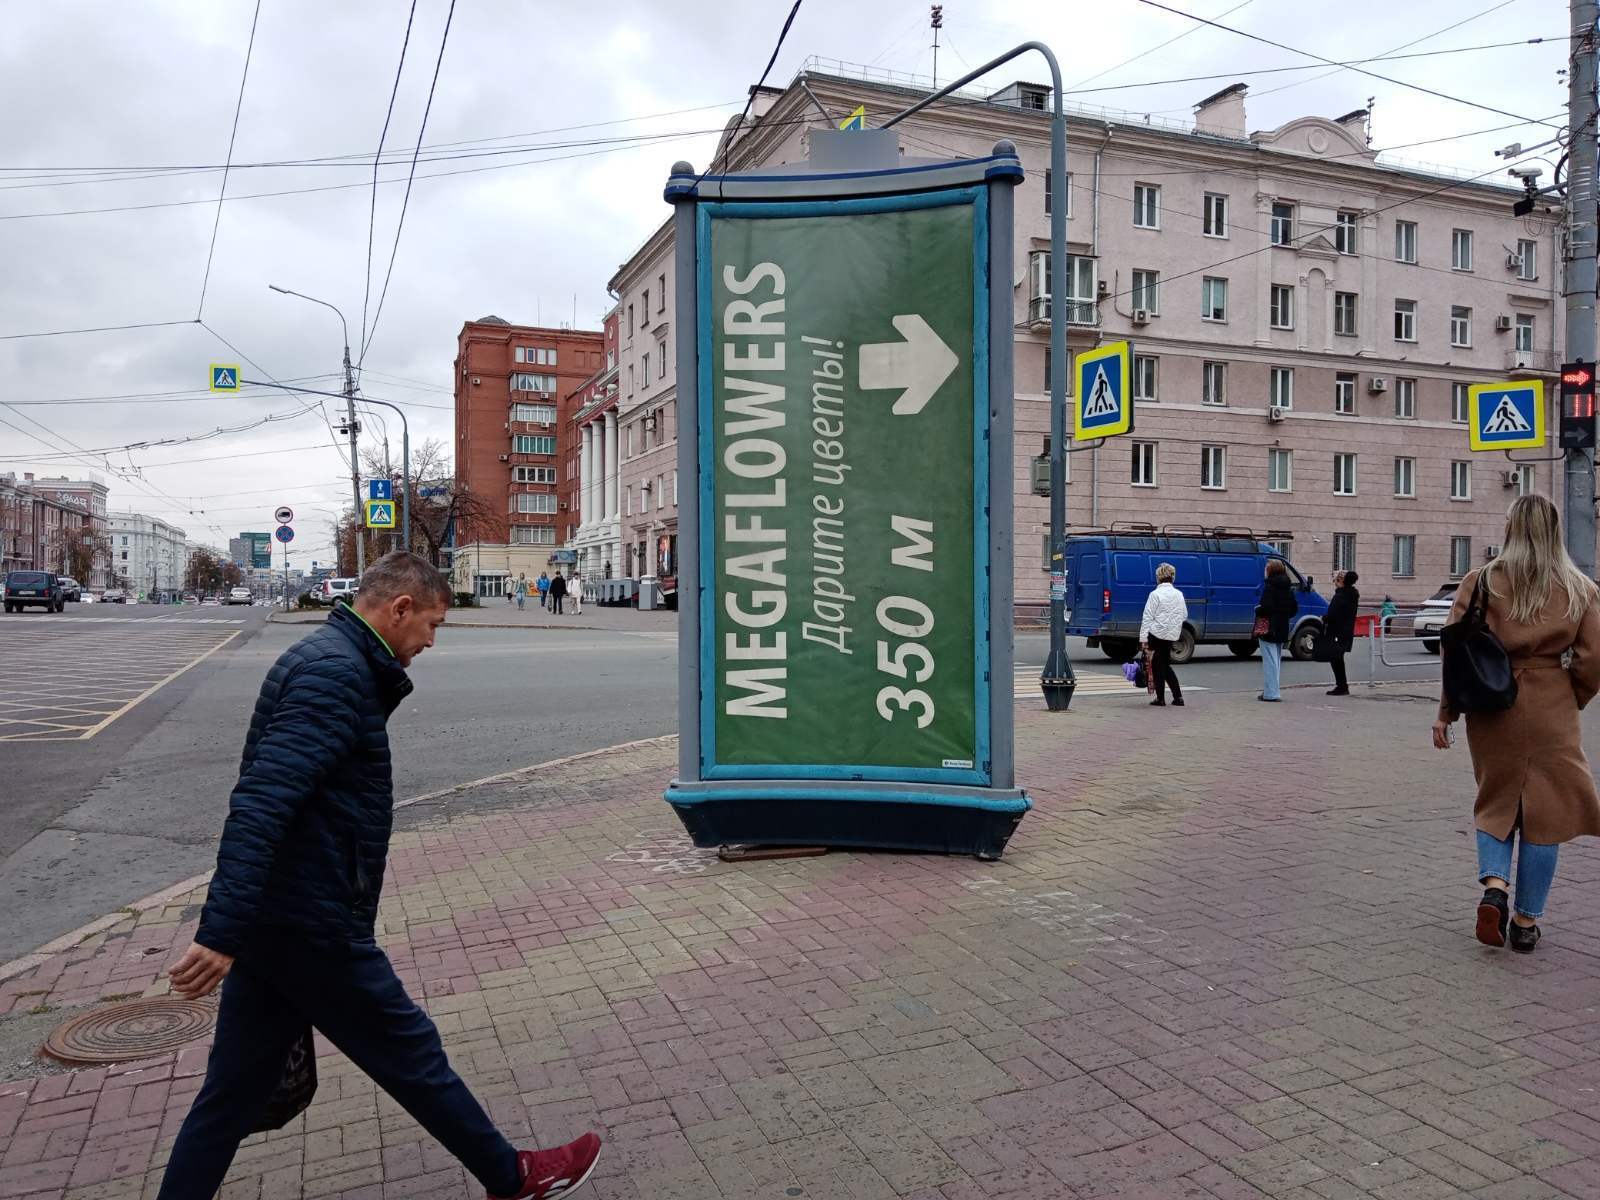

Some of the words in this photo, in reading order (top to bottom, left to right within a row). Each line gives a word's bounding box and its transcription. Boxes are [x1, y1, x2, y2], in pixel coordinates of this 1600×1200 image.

[801, 335, 852, 485] цветы!
[722, 262, 788, 719] MEGAFLOWERS
[802, 494, 855, 655] Дарите
[876, 595, 935, 729] 350
